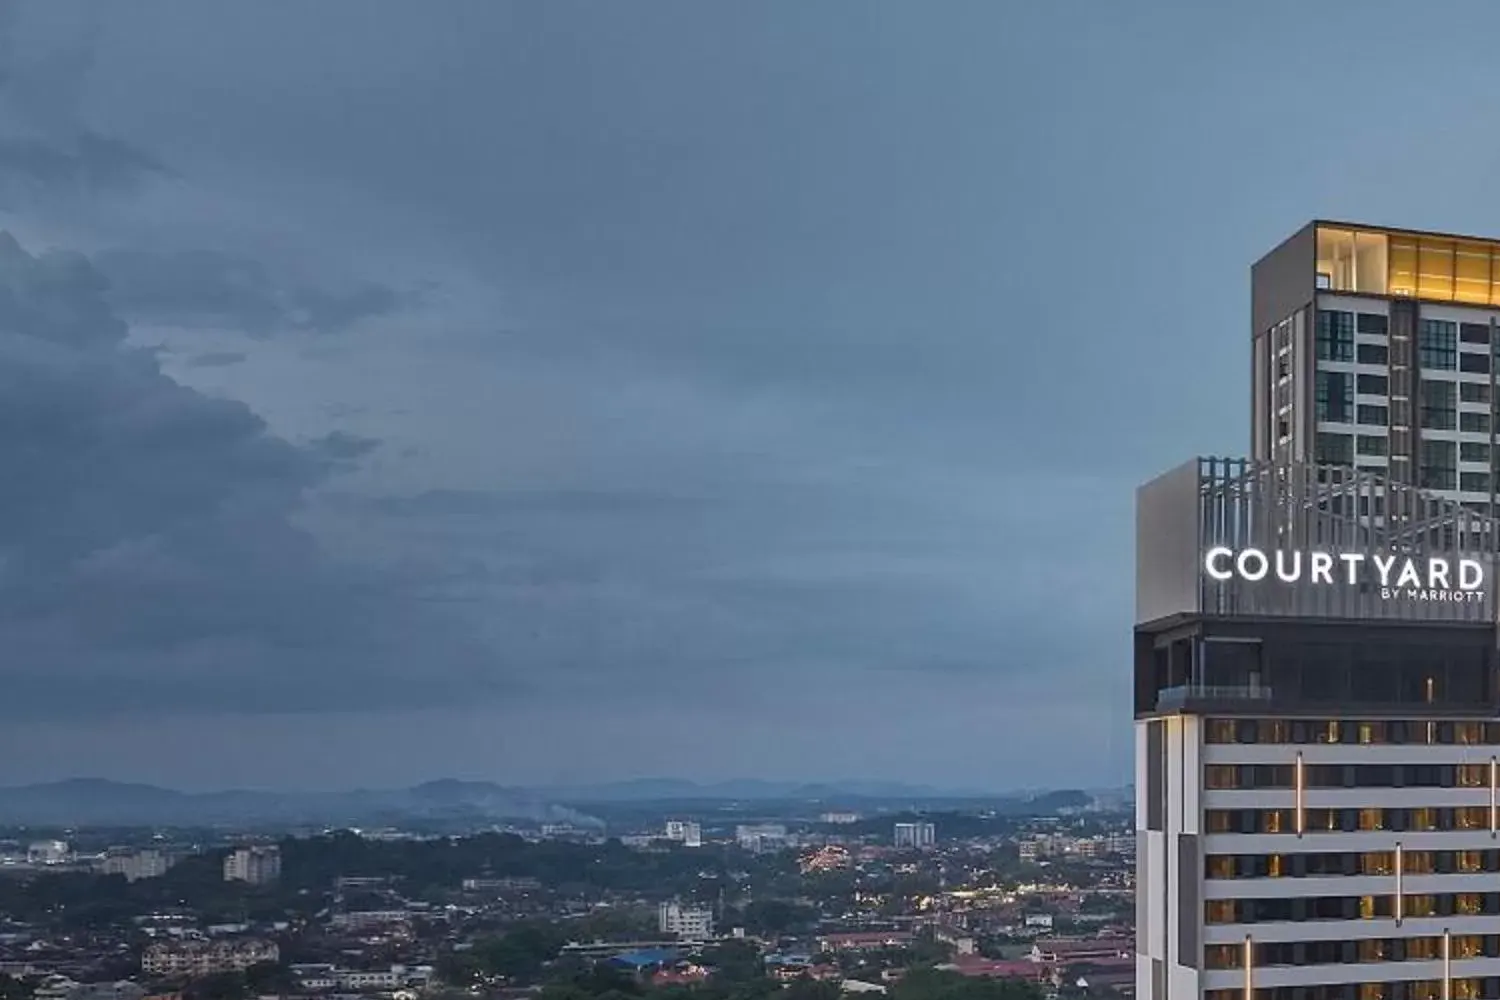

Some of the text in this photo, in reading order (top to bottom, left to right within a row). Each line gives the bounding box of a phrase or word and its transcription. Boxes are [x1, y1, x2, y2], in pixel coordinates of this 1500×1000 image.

[1205, 548, 1484, 590] COURTYARD
[1381, 587, 1485, 602] BY MARRIOTT
